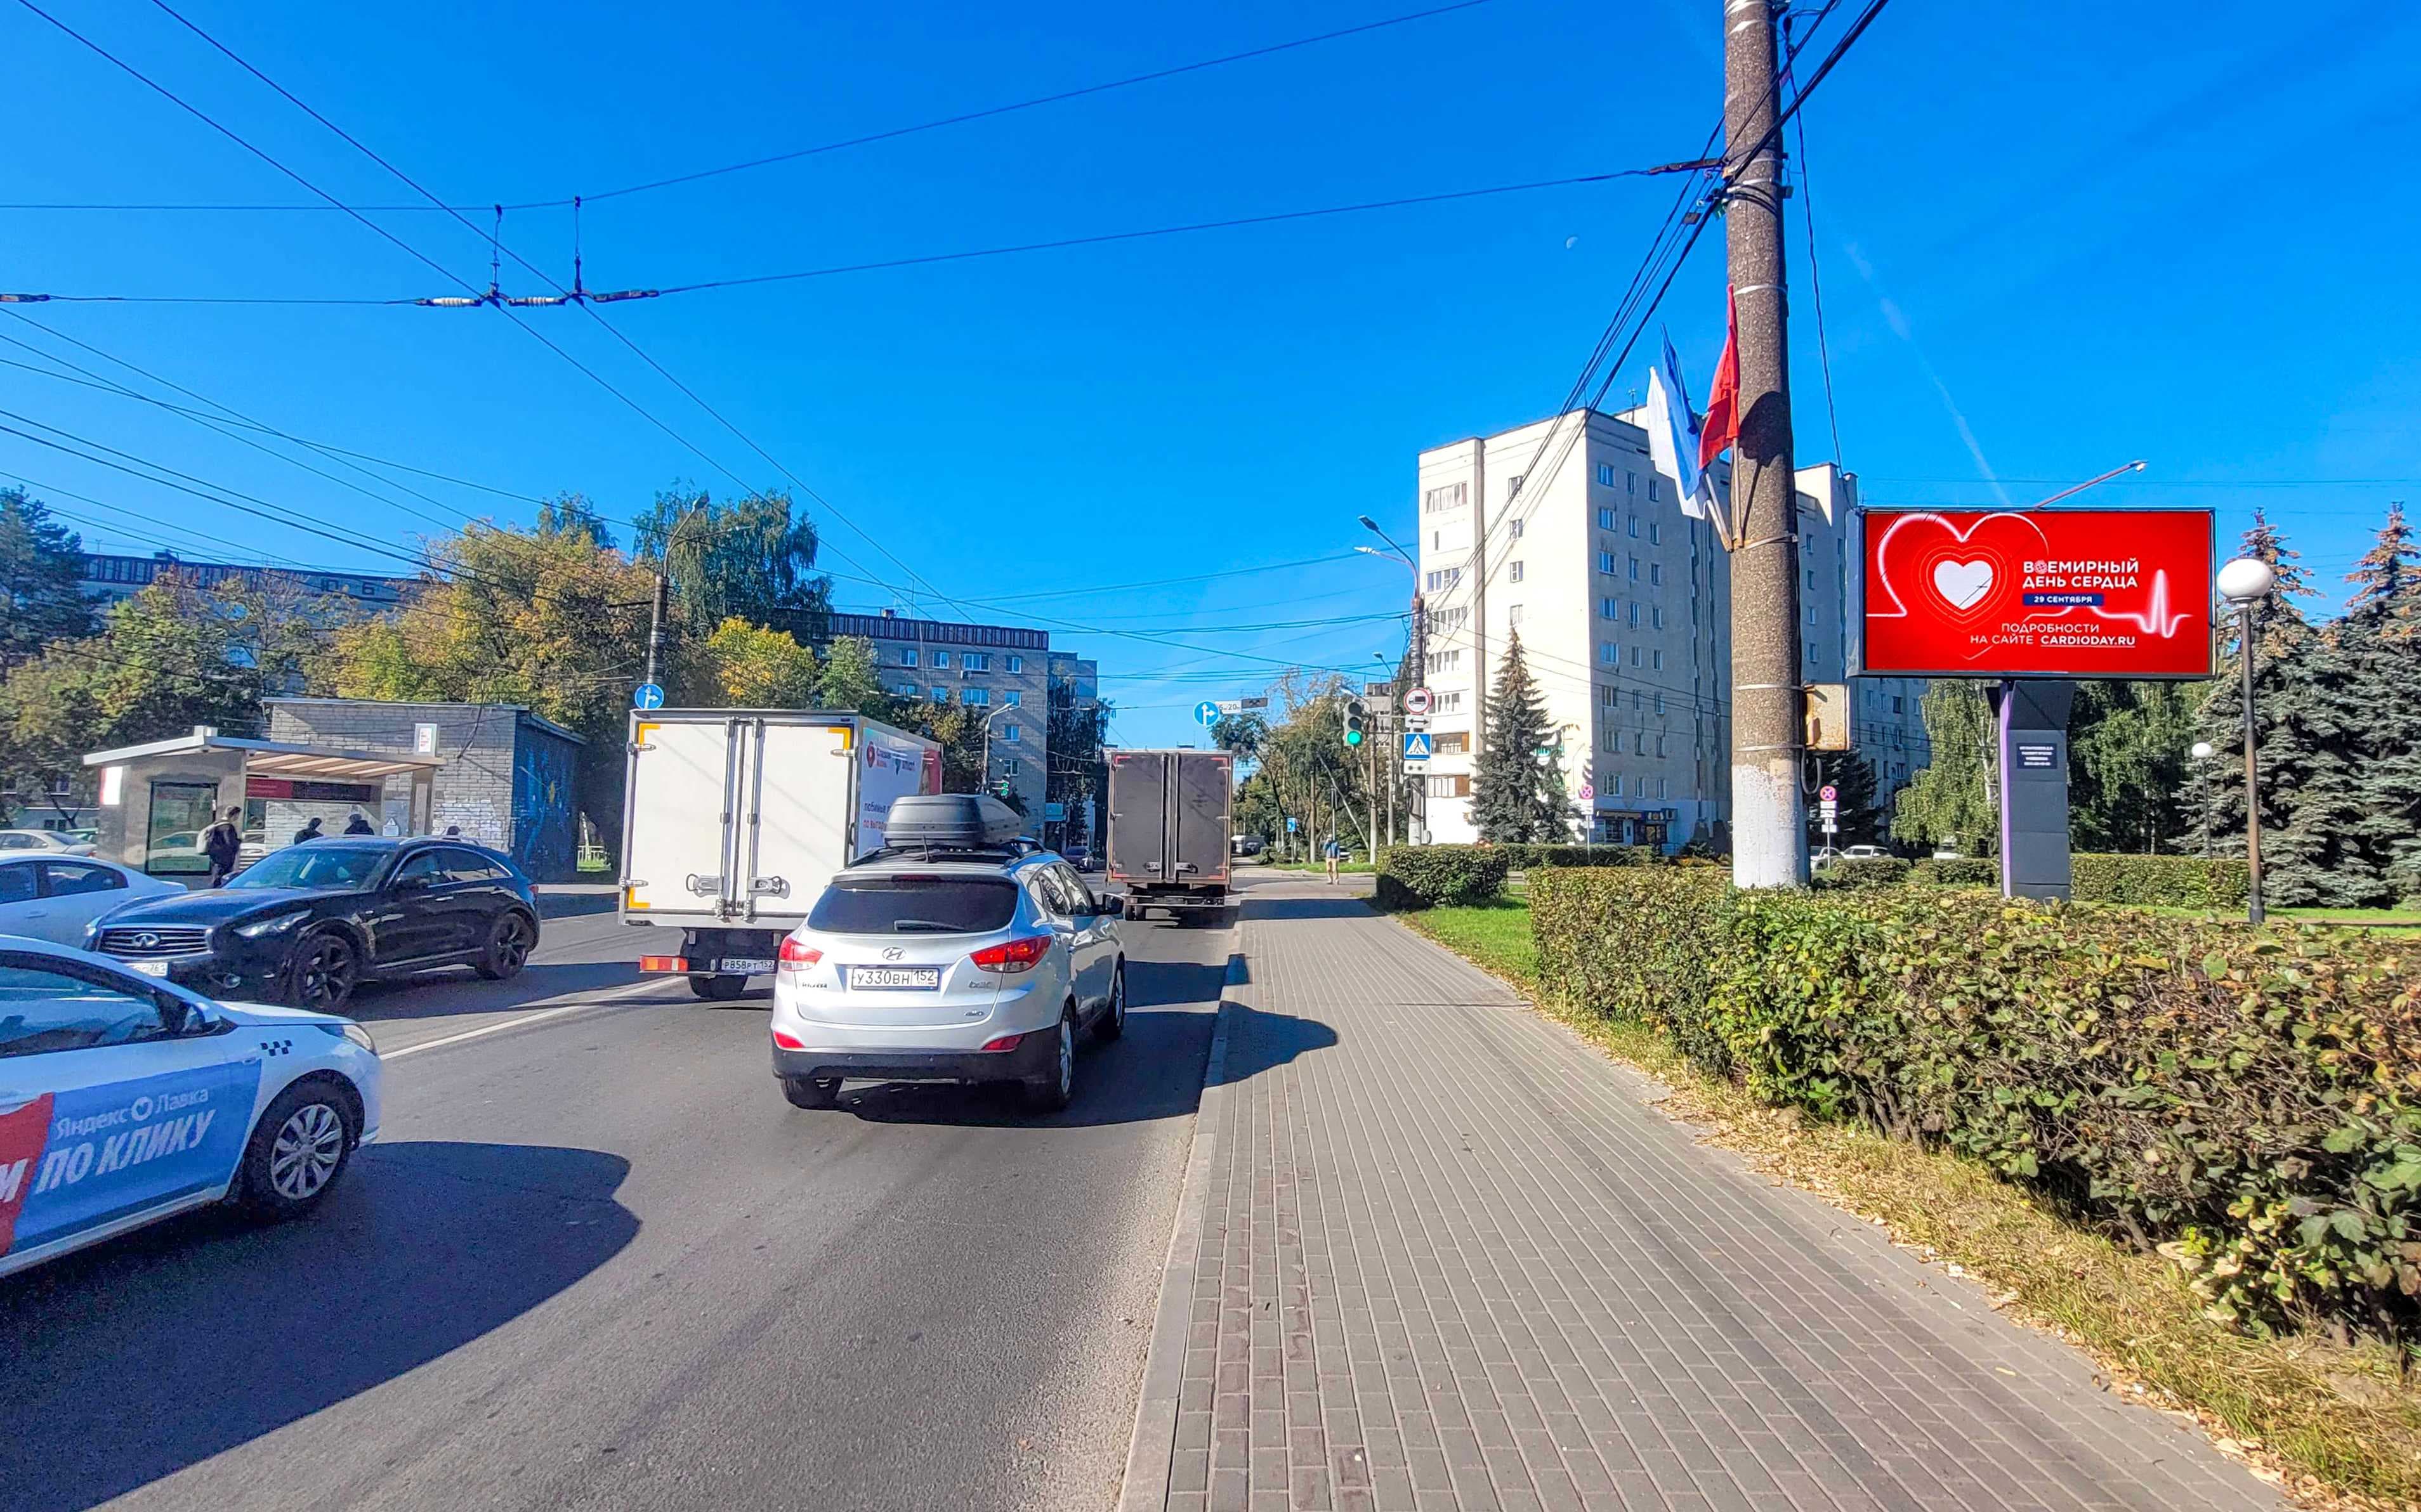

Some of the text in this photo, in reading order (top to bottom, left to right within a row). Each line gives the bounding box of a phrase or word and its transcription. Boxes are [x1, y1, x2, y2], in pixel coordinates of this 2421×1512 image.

[2023, 558, 2139, 573] ВЕМИРНЫЙ
[2023, 576, 2138, 589] ДЕНЬ СЕРДЦА
[2002, 623, 2099, 634] ПОДРОБНОСТИ
[1971, 634, 2136, 646] НА САЙТЕ CARDIODAY.RU
[857, 970, 934, 984] У330ВН 152
[56, 1088, 208, 1140] Яндекс Лавка
[35, 1142, 95, 1195] ПО
[96, 1109, 216, 1175] КЛИКУ
